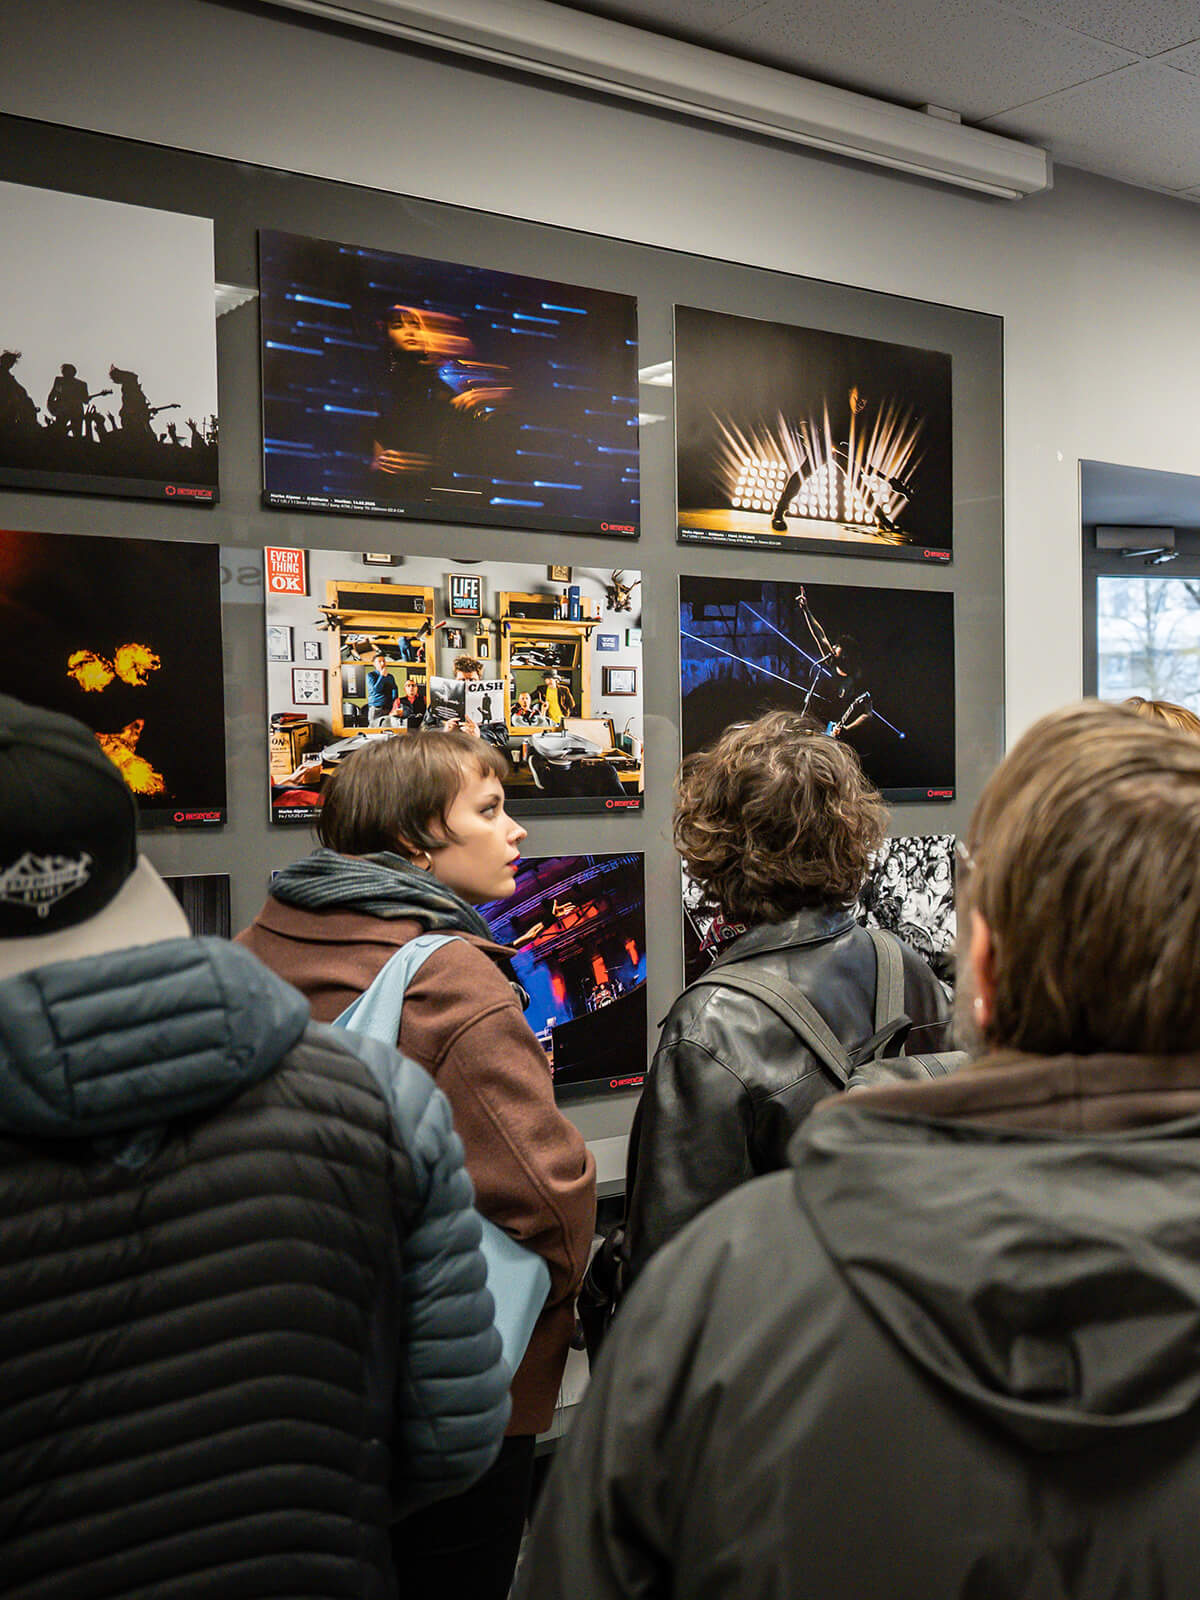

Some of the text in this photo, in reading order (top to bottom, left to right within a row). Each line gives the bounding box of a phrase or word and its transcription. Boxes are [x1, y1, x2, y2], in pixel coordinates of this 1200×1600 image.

[270, 550, 299, 563] EVERY
[271, 561, 299, 573] THING
[271, 576, 301, 591] OK
[453, 578, 478, 598] LIFE
[468, 682, 504, 692] CASH
